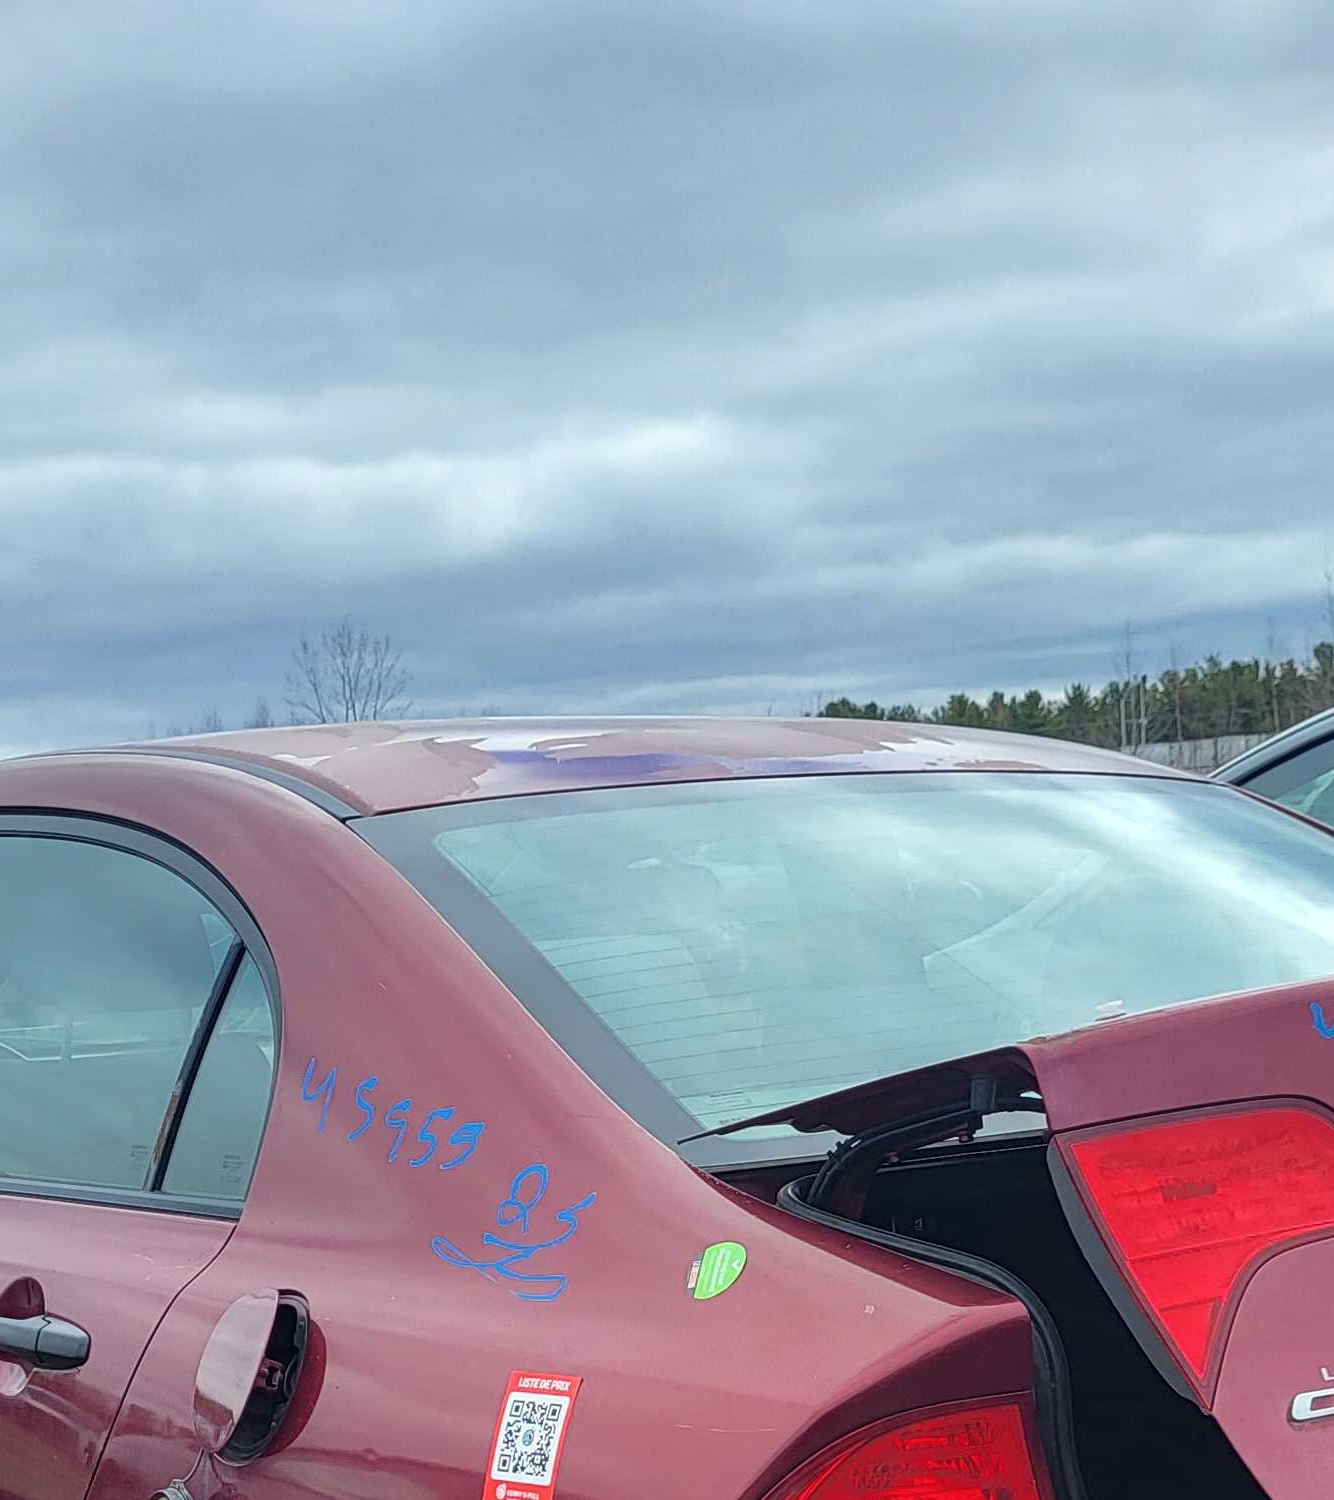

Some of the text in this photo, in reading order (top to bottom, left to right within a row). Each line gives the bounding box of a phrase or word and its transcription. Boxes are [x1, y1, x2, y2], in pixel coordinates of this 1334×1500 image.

[517, 1376, 572, 1391] LISTE DE PRIX
